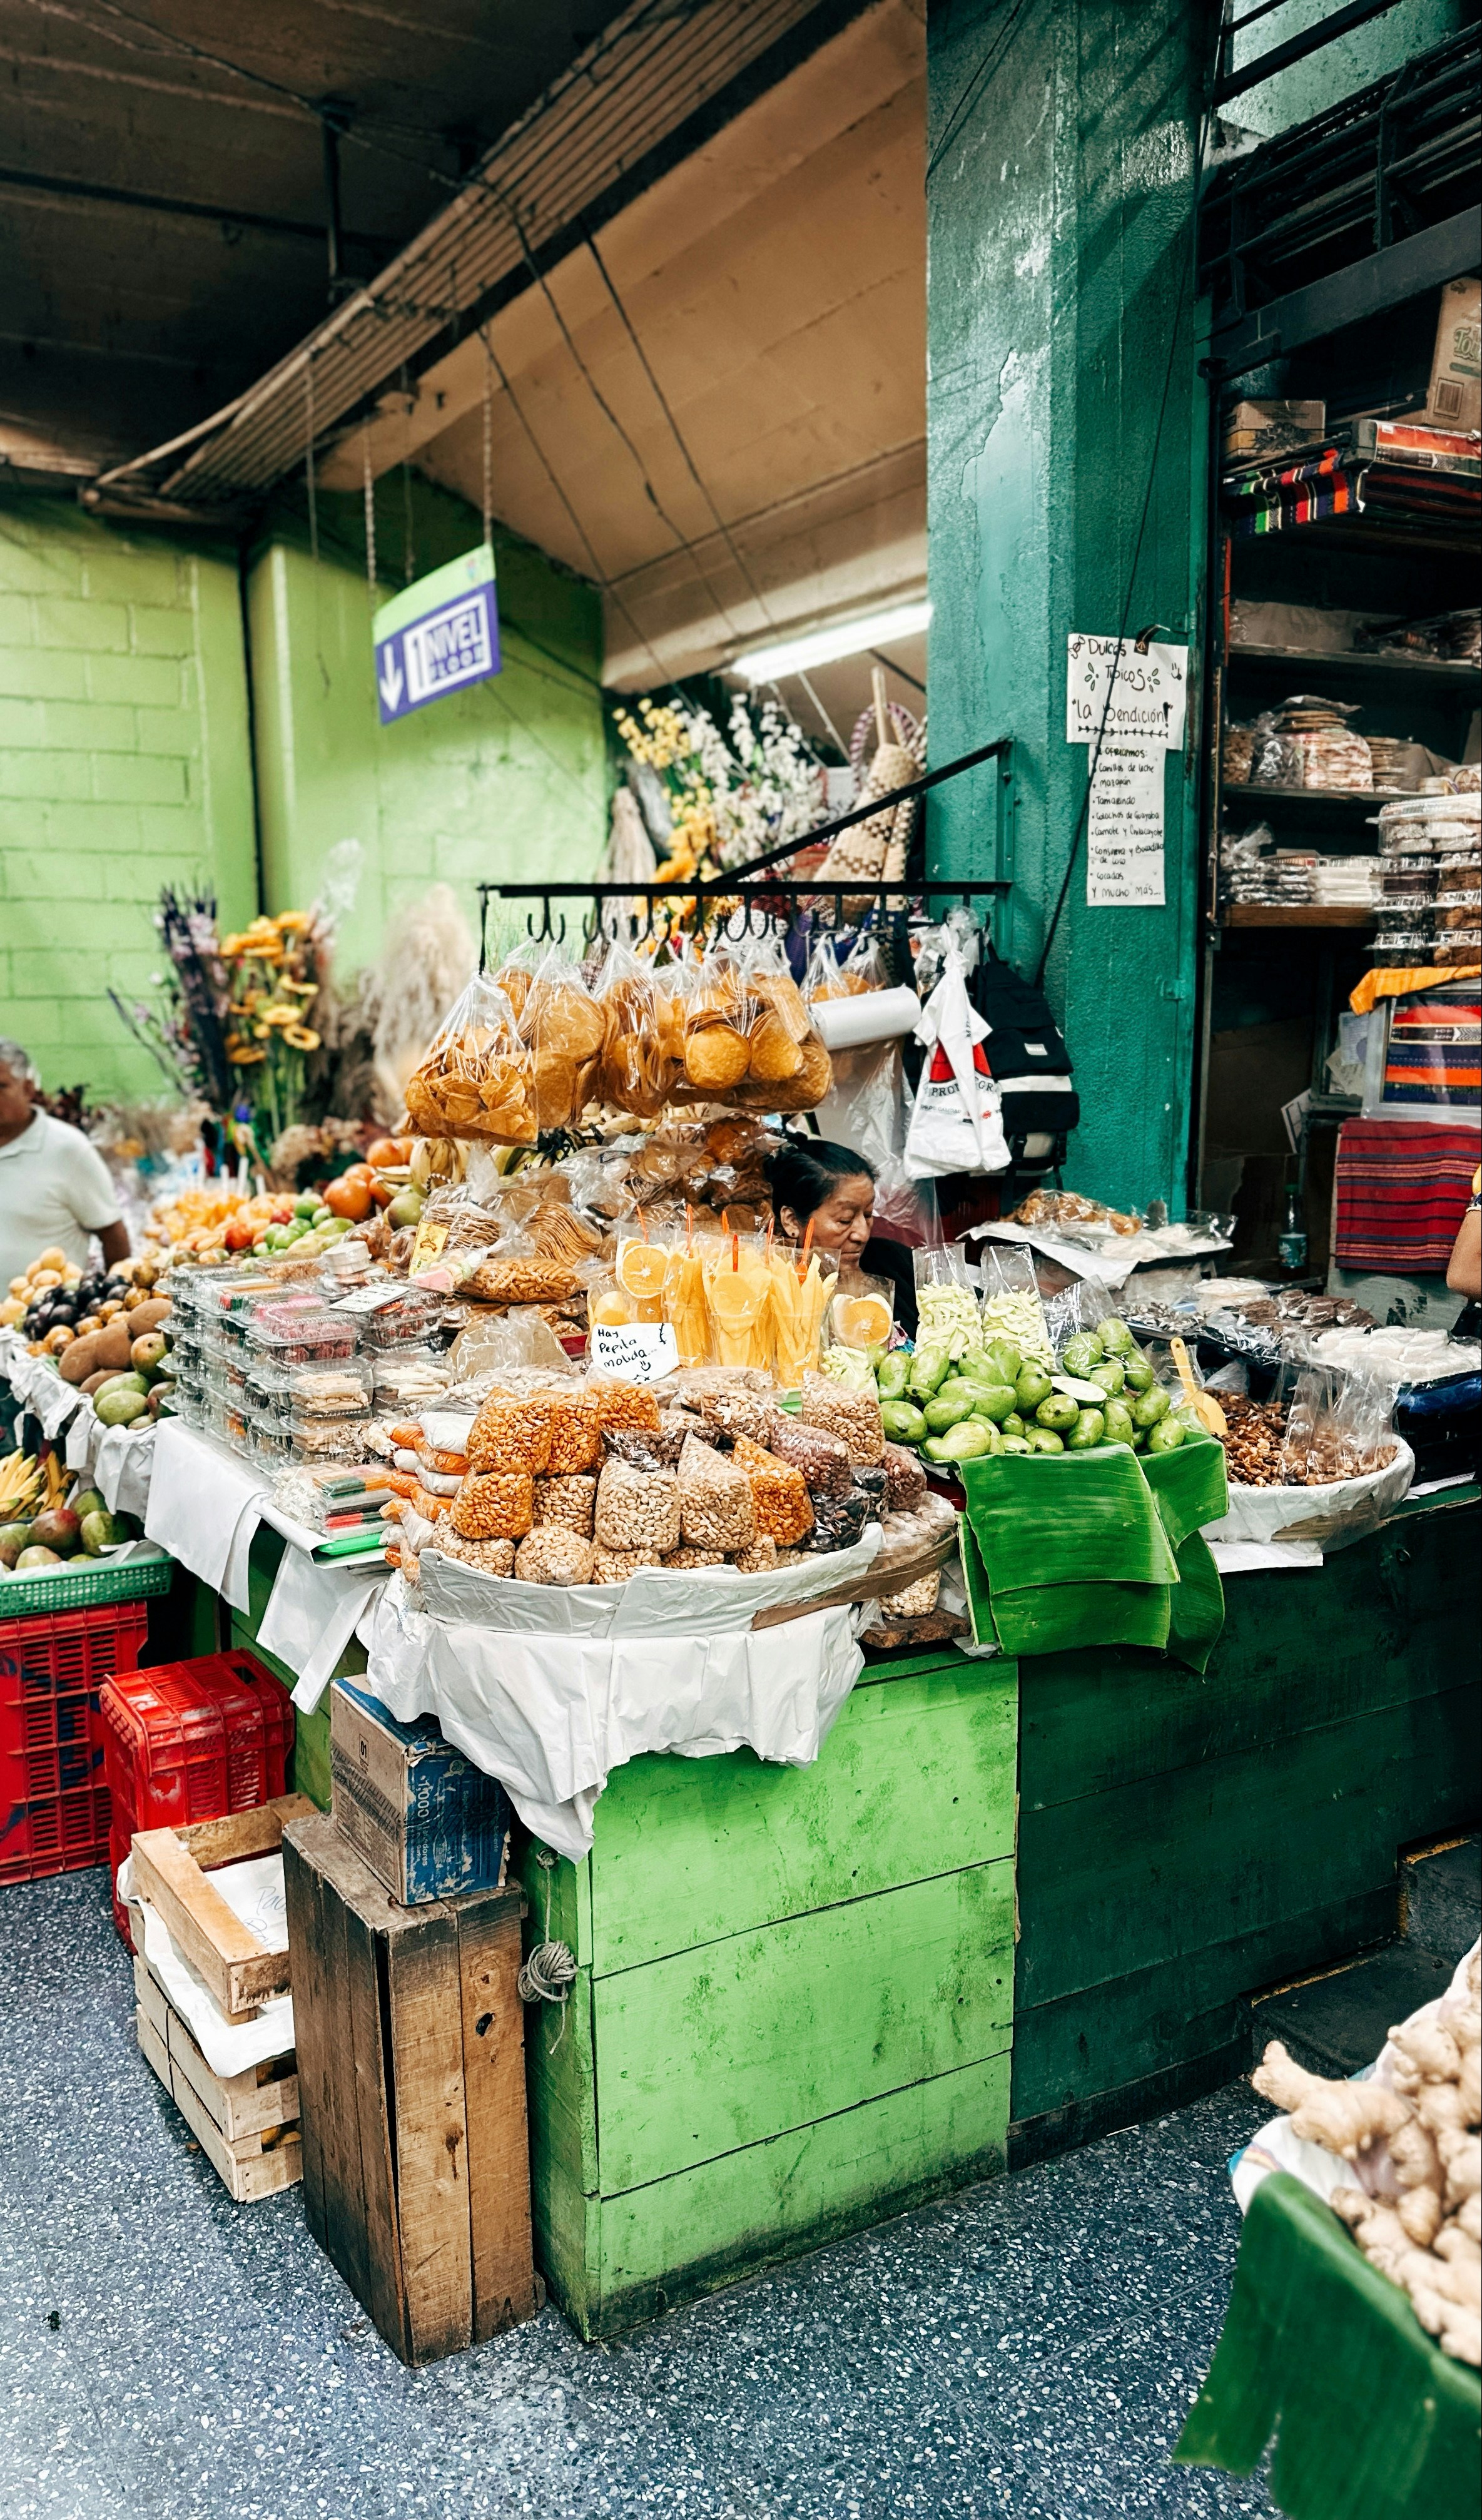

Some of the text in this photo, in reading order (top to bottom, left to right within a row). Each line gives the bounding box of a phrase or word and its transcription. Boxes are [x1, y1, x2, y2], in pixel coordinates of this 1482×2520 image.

[425, 610, 482, 663] NIVEL
[1088, 638, 1127, 657] Dulces
[1128, 763, 1136, 773] de
[1126, 811, 1133, 820] de
[1095, 825, 1119, 836] Camote
[1100, 856, 1107, 864] de
[597, 1328, 619, 1338] Hay
[599, 1338, 637, 1354] Pepita
[422, 1826, 430, 1867] dores
